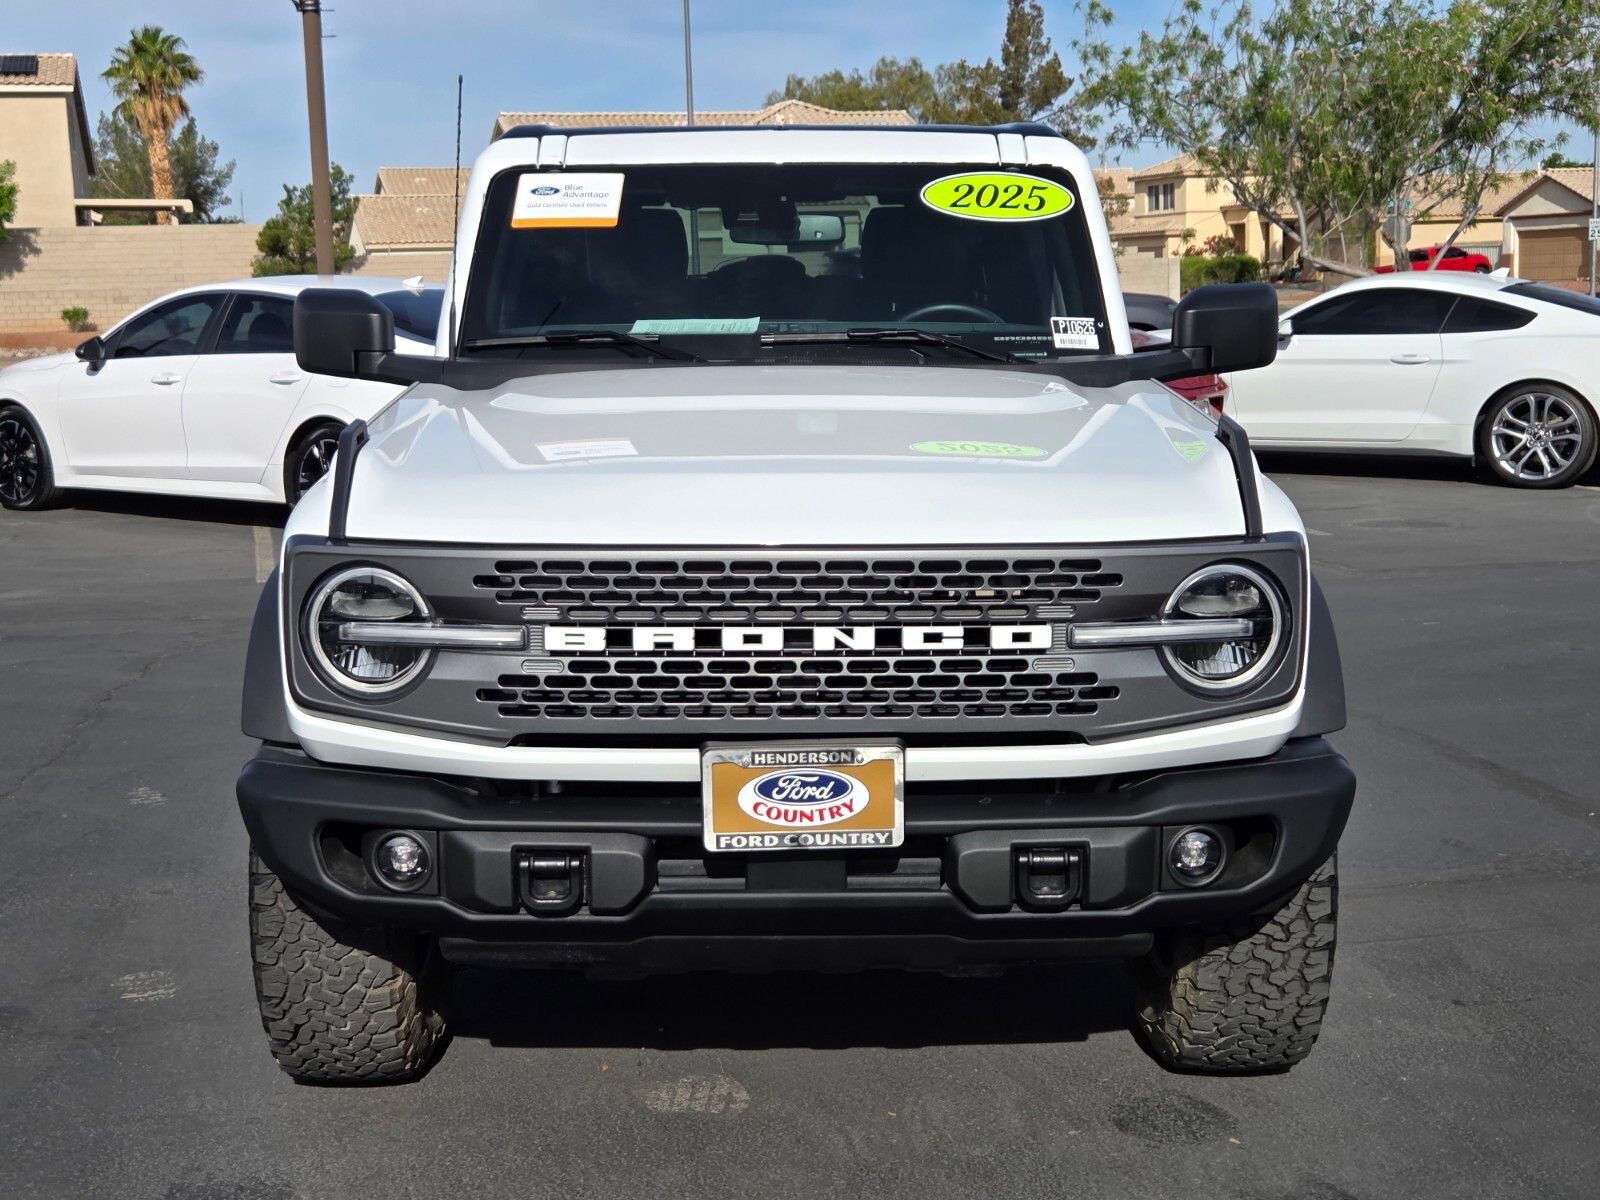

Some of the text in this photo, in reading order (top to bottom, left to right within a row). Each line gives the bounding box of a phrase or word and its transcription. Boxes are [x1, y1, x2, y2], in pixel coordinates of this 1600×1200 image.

[534, 187, 556, 196] Ford
[563, 191, 609, 199] Advantage
[949, 183, 1049, 212] 2025
[1059, 320, 1096, 335] P10626
[544, 625, 1052, 651] BRONCO
[754, 751, 852, 765] HENDERSON
[771, 775, 836, 801] Ford
[752, 799, 855, 823] COUNTRY
[719, 832, 891, 848] FORD COUNTRY
